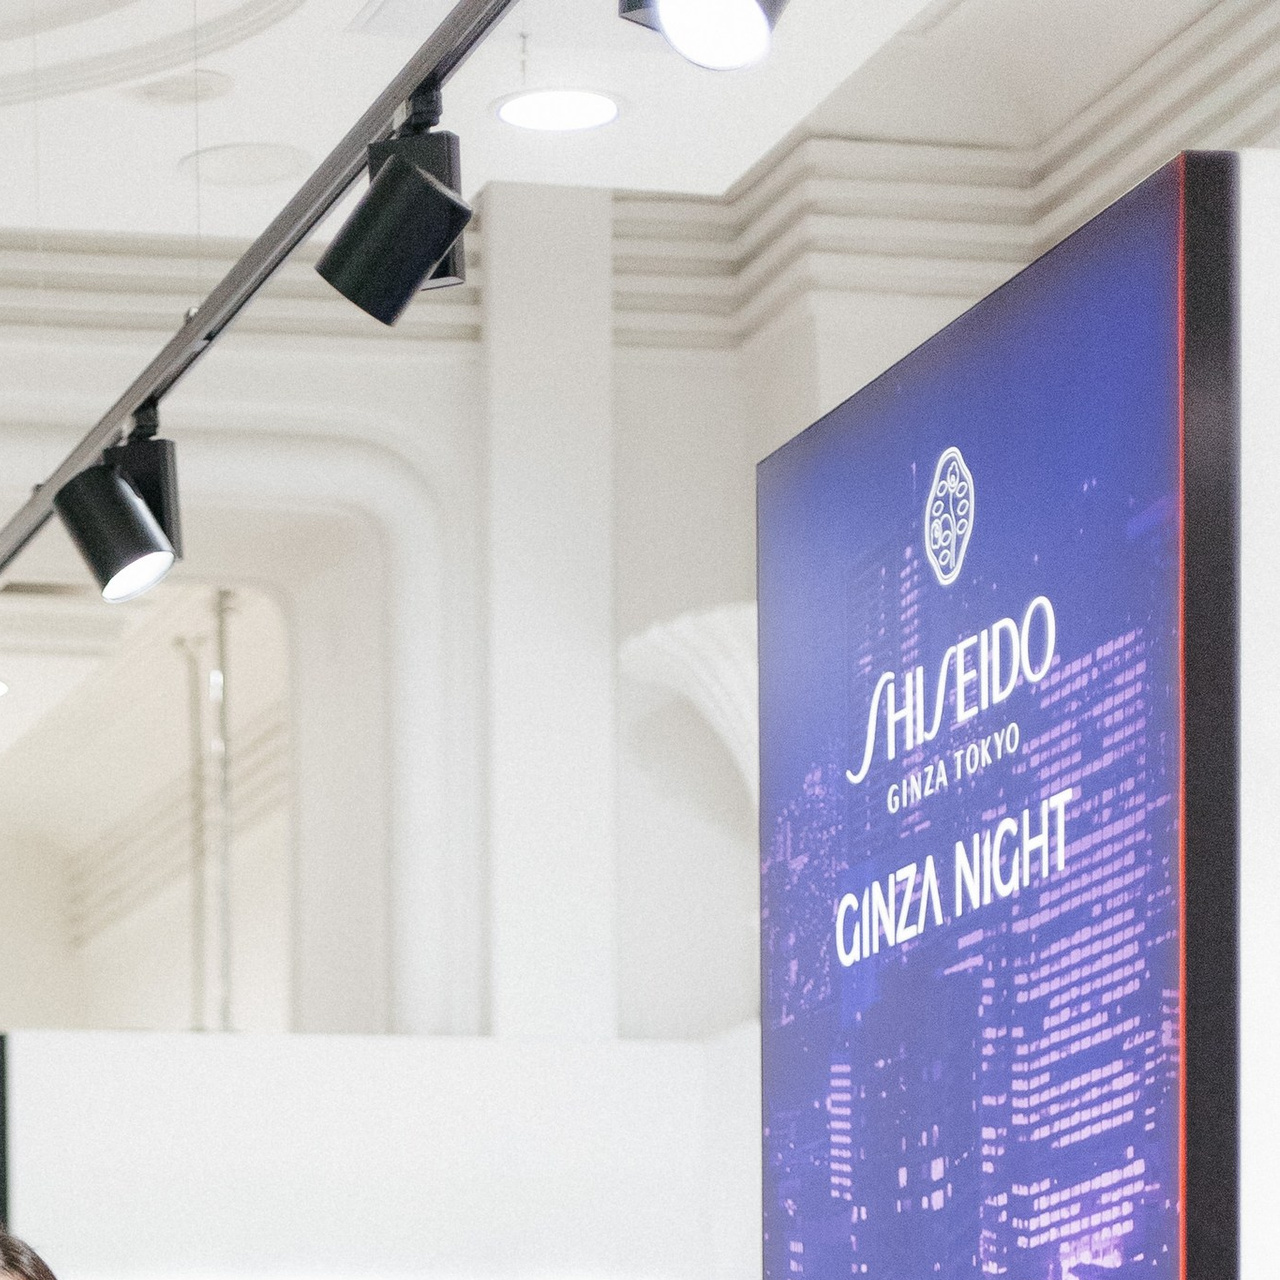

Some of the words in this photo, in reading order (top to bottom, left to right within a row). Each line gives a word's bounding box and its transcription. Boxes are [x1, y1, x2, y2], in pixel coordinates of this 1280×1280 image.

[846, 596, 1056, 784] SHISEIDO
[887, 759, 948, 813] GINZA
[954, 723, 1019, 780] TOKYO
[835, 855, 943, 967] GINZA
[955, 788, 1072, 917] NIGHT
